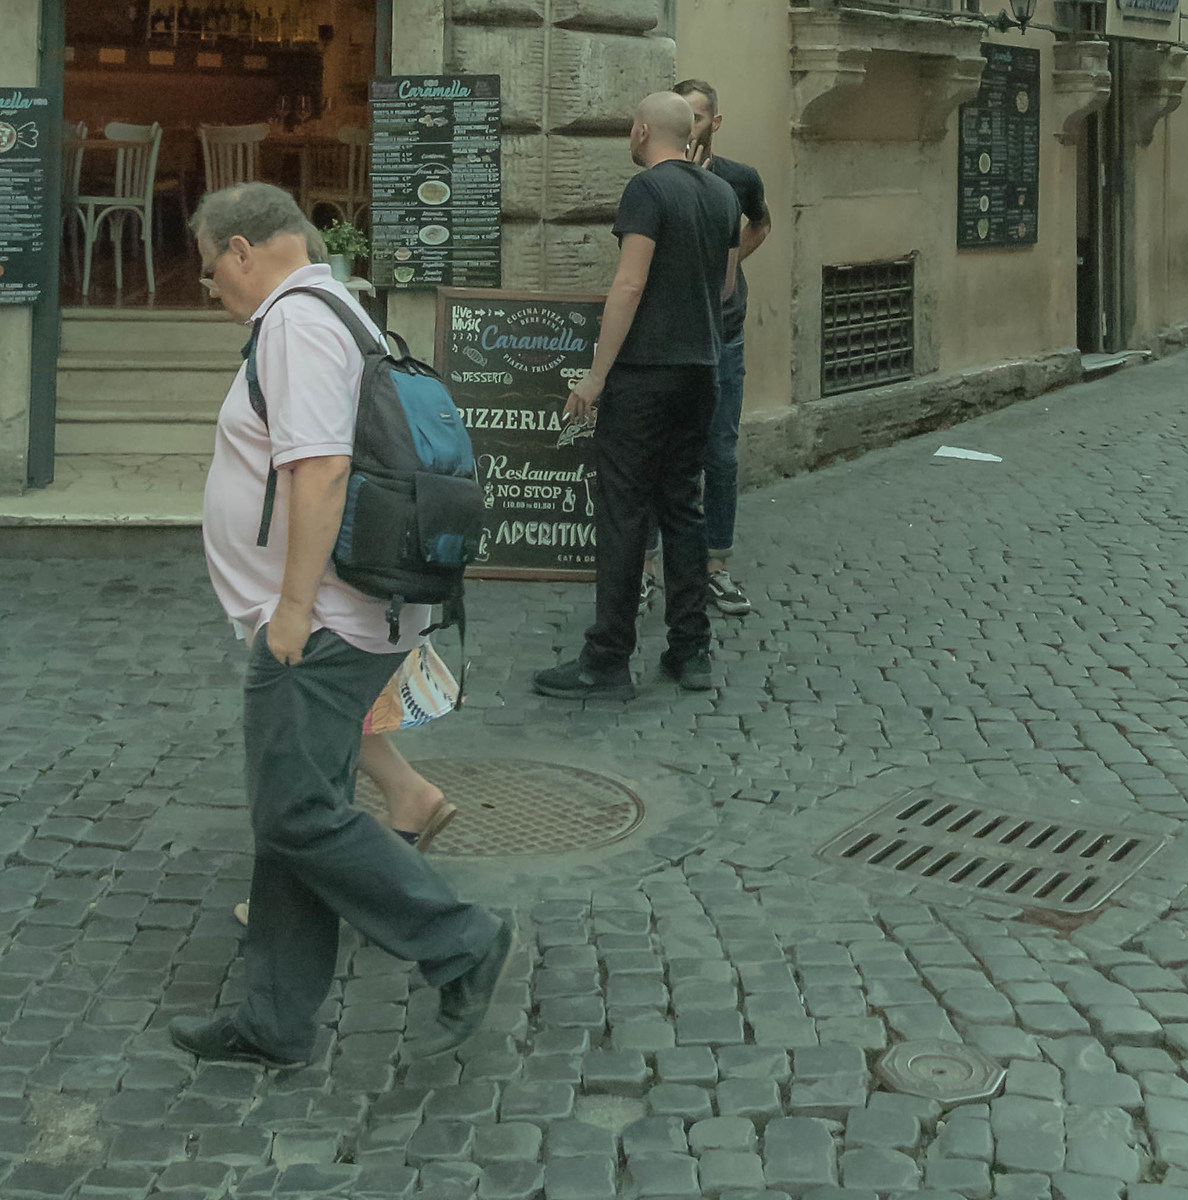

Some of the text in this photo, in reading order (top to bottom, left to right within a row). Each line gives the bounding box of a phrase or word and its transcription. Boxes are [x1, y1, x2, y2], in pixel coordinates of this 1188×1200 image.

[400, 80, 472, 99] Caramella
[507, 307, 538, 325] CUCINA
[481, 324, 589, 352] Caramella
[503, 353, 566, 373] PIAZZA TRILUSSA
[462, 371, 506, 384] DESSERT
[478, 453, 585, 482] Restaurant
[497, 484, 562, 499] NO STOP
